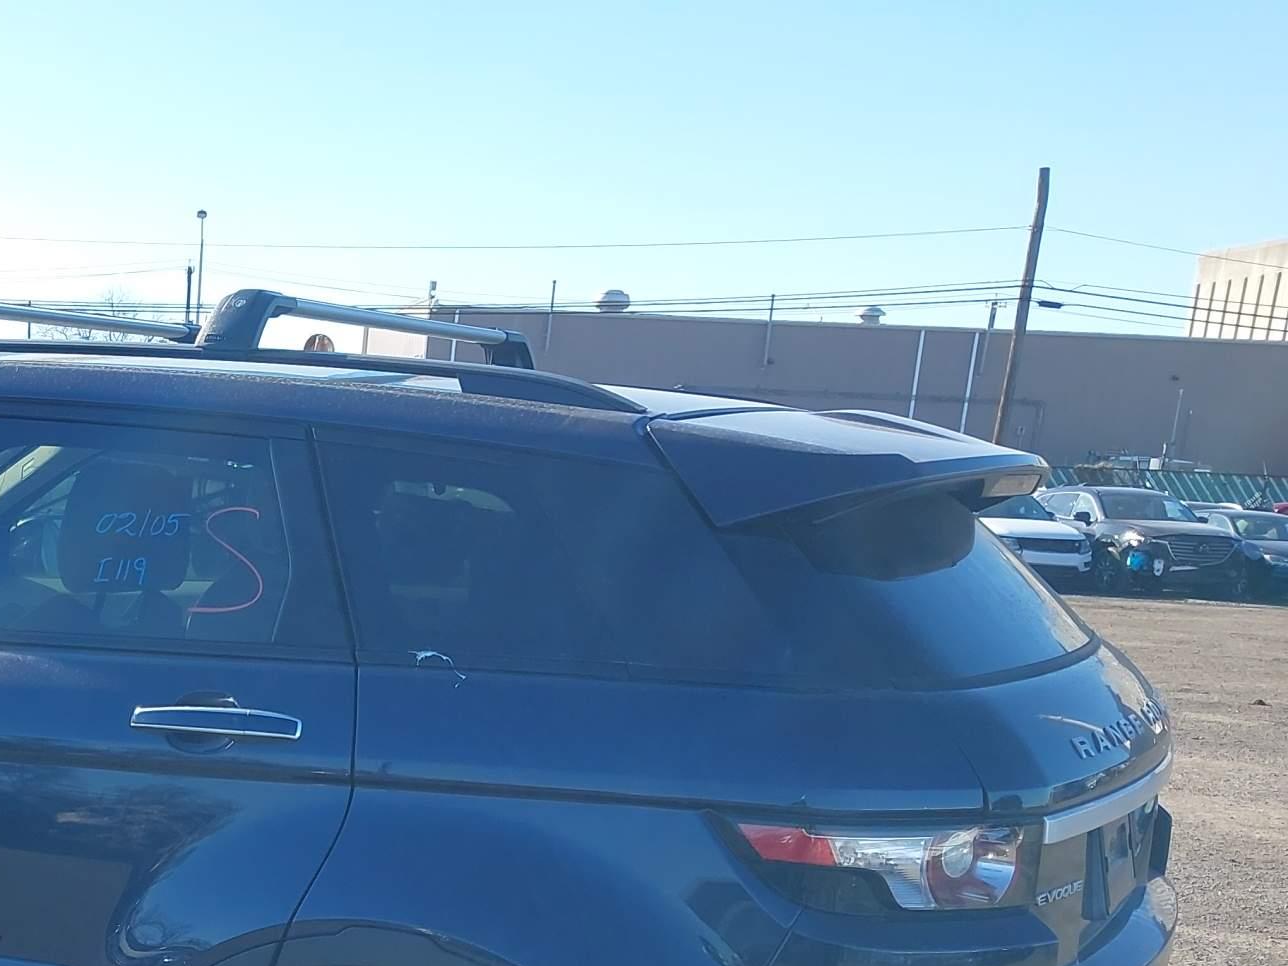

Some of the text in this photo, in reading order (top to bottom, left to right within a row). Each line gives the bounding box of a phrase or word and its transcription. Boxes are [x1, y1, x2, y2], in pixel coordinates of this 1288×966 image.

[96, 509, 191, 537] 02/05
[187, 506, 263, 613] S
[1072, 713, 1144, 760] RANGE
[1037, 879, 1083, 906] EVOQUE
